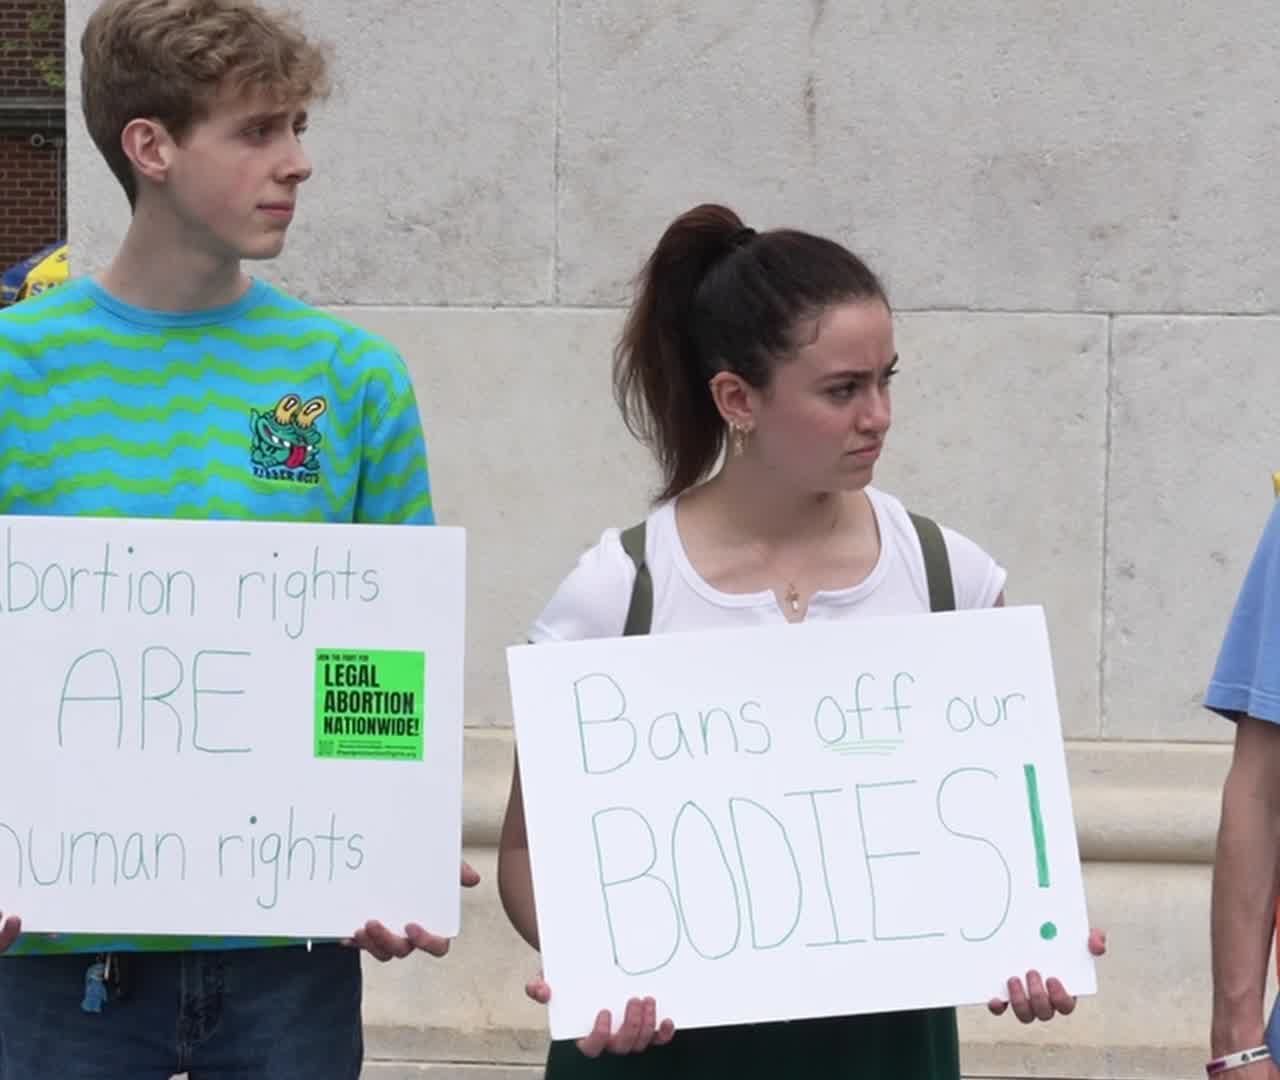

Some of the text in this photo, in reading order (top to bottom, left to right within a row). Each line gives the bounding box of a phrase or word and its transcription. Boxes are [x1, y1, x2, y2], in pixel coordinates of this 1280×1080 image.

[237, 546, 380, 639] rights
[57, 646, 252, 753] ARE
[324, 663, 380, 688] LEGAL
[324, 690, 415, 715] ABORTION
[573, 672, 1026, 774] Bans off our
[323, 716, 420, 737] NATIONWIDE!
[218, 805, 365, 909] rights
[592, 764, 1058, 976] BODIES!
